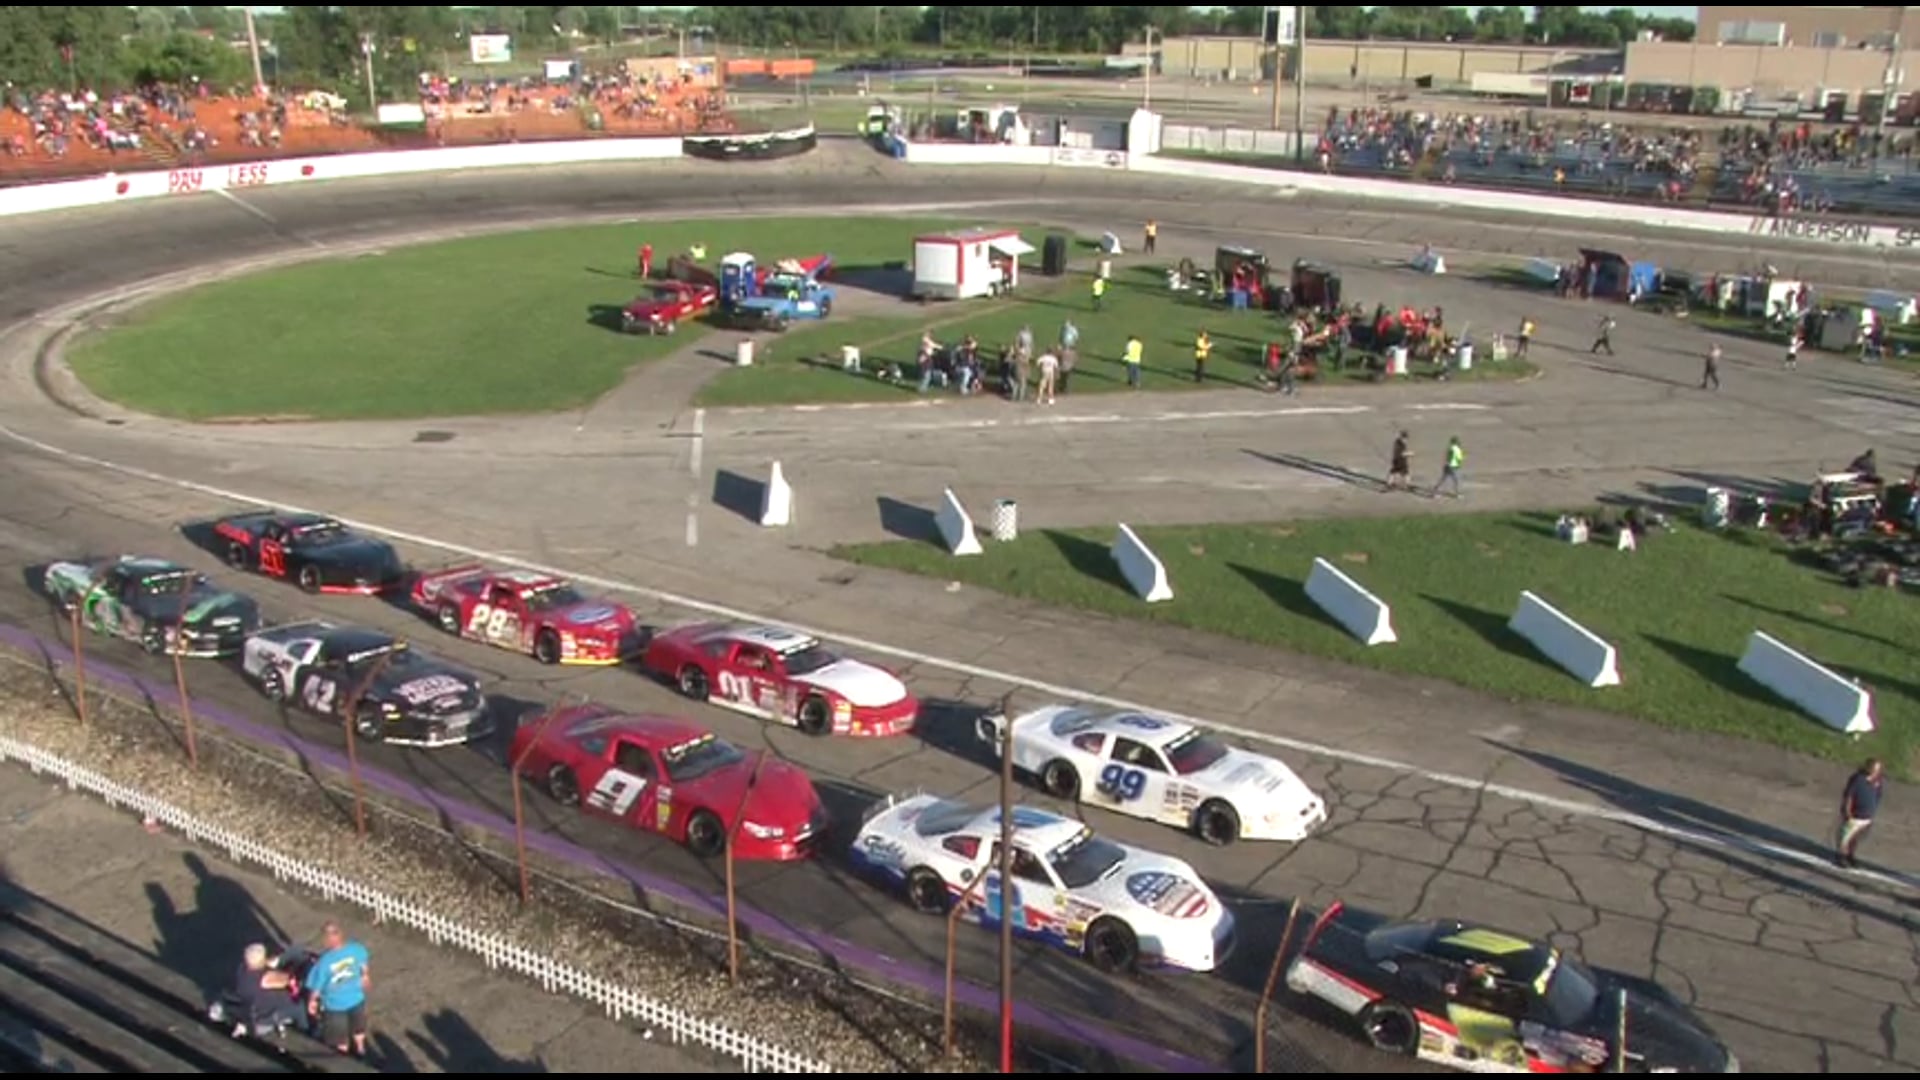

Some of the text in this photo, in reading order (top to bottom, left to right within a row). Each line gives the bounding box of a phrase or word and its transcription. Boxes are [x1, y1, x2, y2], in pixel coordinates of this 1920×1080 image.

[168, 163, 268, 193] PAY LESS
[1770, 218, 1870, 243] ANDERSON
[468, 603, 508, 638] 28
[303, 674, 336, 712] 42
[586, 768, 647, 816] 9
[1099, 764, 1147, 802] 99
